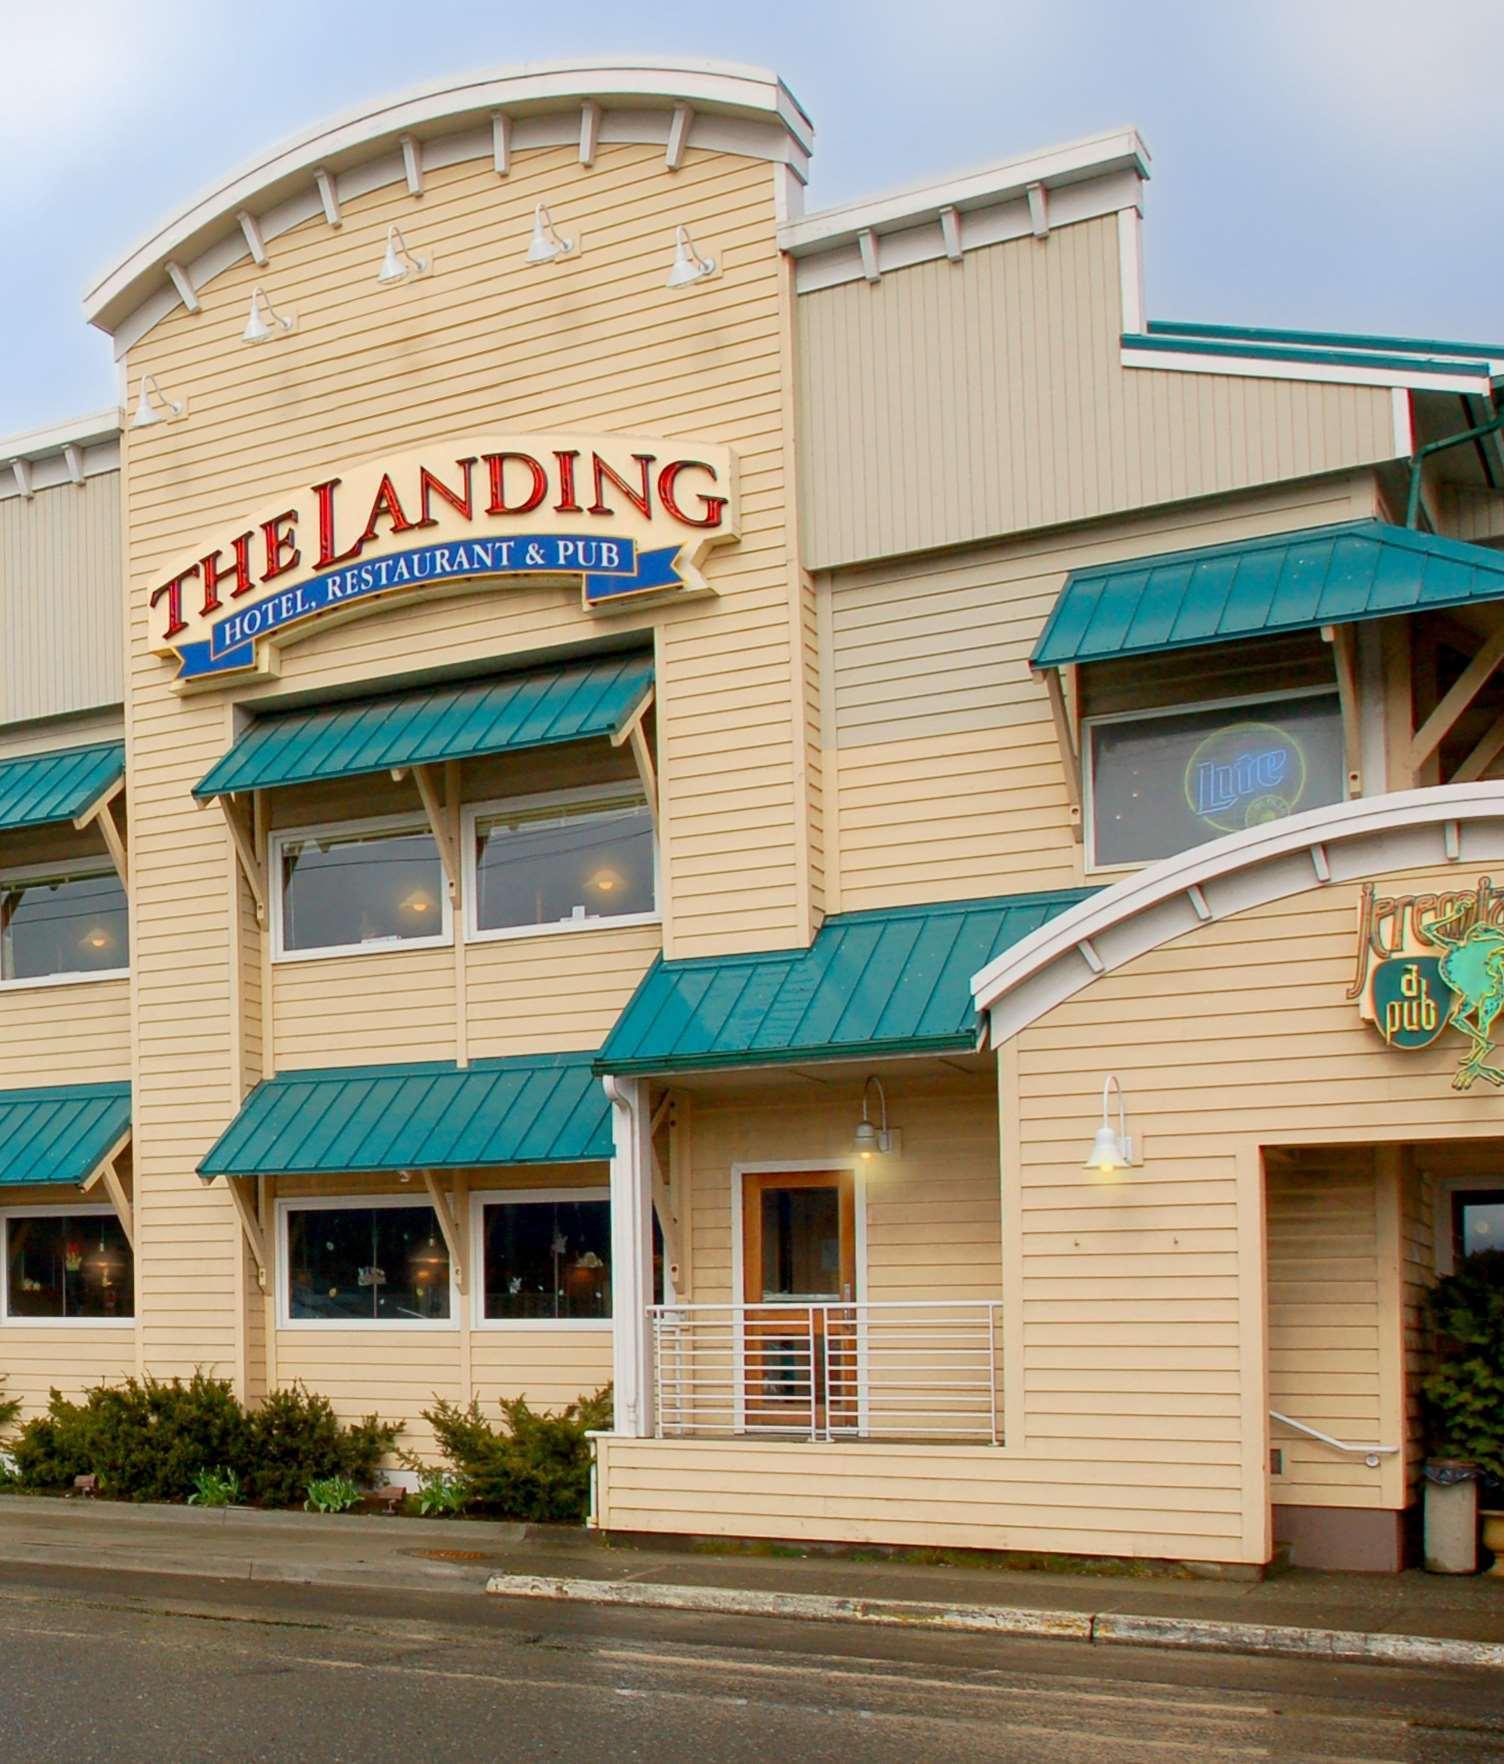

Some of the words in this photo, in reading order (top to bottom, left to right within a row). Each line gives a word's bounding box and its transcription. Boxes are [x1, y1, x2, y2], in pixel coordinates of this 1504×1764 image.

[149, 508, 301, 640] THE
[310, 449, 729, 571] LANDING
[223, 588, 317, 646] HOTEL,
[326, 540, 515, 601] RESTAURANT
[525, 540, 545, 565] &
[557, 539, 620, 568] PUB
[1386, 977, 1438, 1046] pub
